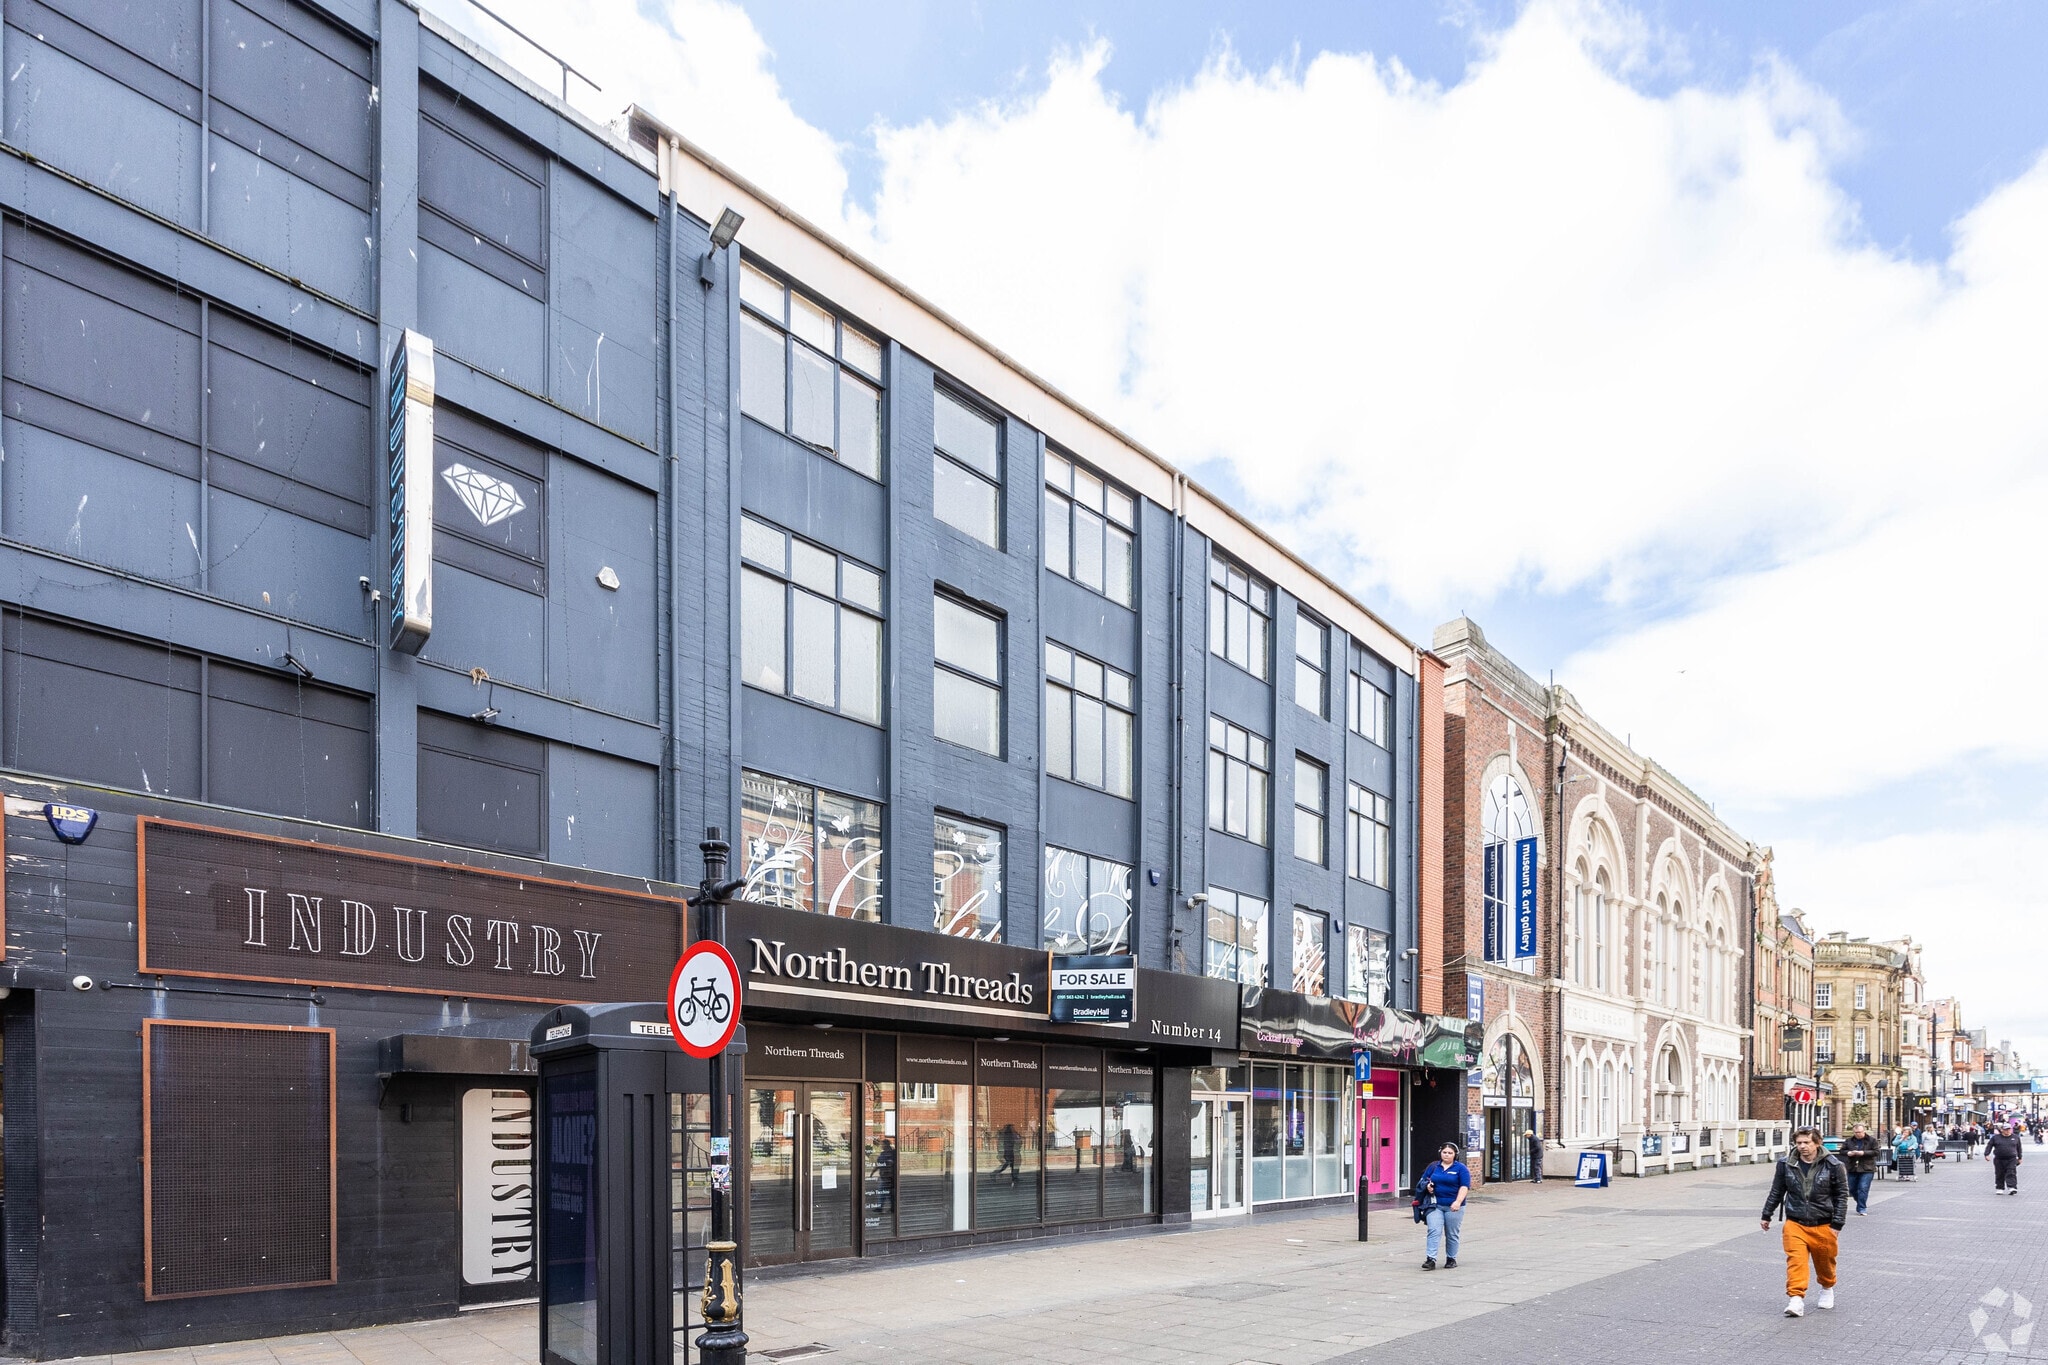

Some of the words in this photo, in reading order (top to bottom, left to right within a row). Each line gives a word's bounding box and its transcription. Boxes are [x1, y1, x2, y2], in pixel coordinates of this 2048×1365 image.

[390, 347, 404, 625] INDUSTRY
[51, 805, 90, 820] IDS
[1522, 844, 1531, 887] museum
[1522, 889, 1532, 898] &
[1521, 900, 1531, 914] art
[244, 887, 602, 979] INDUSTRY
[1520, 916, 1532, 951] gallery
[749, 937, 913, 992] Northern
[919, 960, 1034, 1005] Threads
[1059, 974, 1087, 986] FOR
[1089, 973, 1126, 985] SALE
[1470, 993, 1481, 1022] FR
[549, 1026, 571, 1040] TELEPHONE
[640, 1024, 673, 1035] TELEP
[1150, 1019, 1205, 1039] Number
[1208, 1028, 1222, 1043] 14
[1257, 1030, 1281, 1043] Cocktail
[1282, 1033, 1304, 1047] Lounge
[764, 1045, 808, 1058] Northern
[808, 1047, 845, 1059] Threads
[905, 1056, 968, 1066] www.northernthreads.co.uk
[980, 1058, 1011, 1068] Northern
[1011, 1059, 1038, 1070] Threads
[1107, 1065, 1132, 1075] Northern
[1132, 1066, 1153, 1076] Threads
[491, 1088, 533, 1278] INDUSTRY
